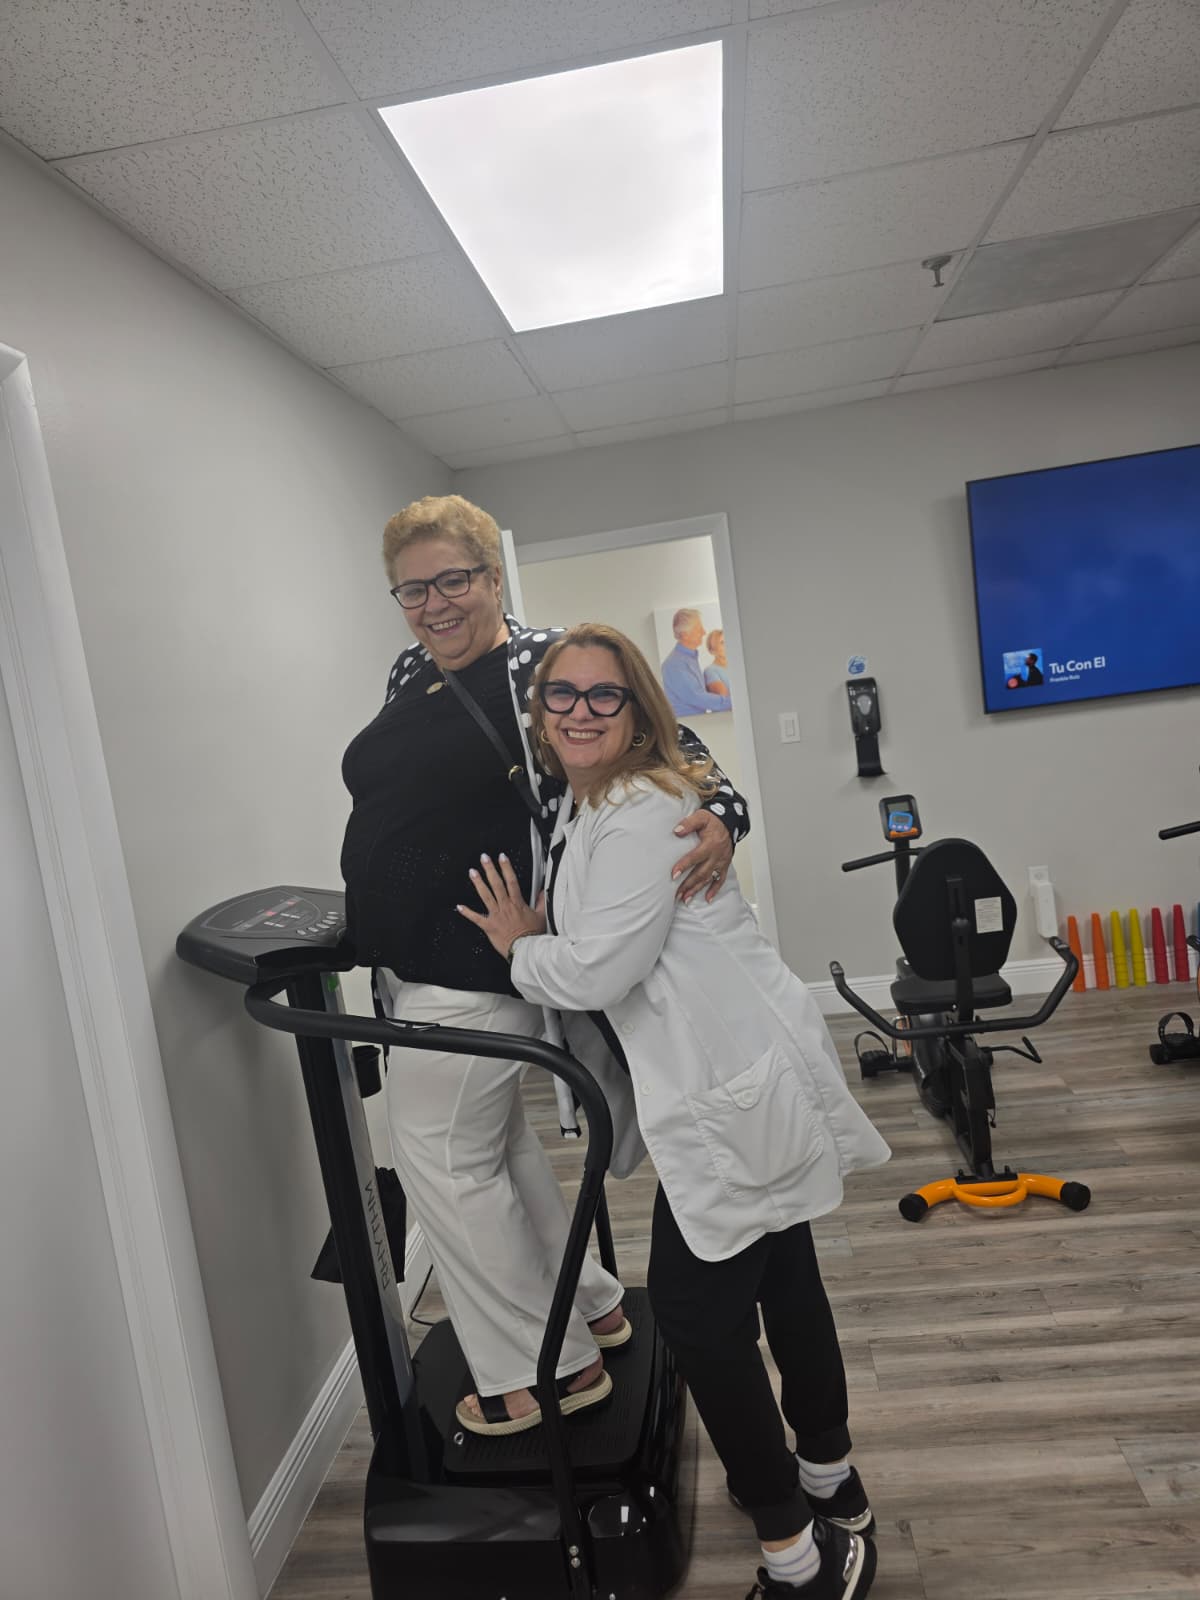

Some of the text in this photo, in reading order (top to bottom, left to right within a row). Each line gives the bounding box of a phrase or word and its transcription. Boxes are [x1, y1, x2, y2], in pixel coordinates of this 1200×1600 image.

[1049, 656, 1105, 675] Tu Con El
[364, 1180, 389, 1290] RHYTHM
